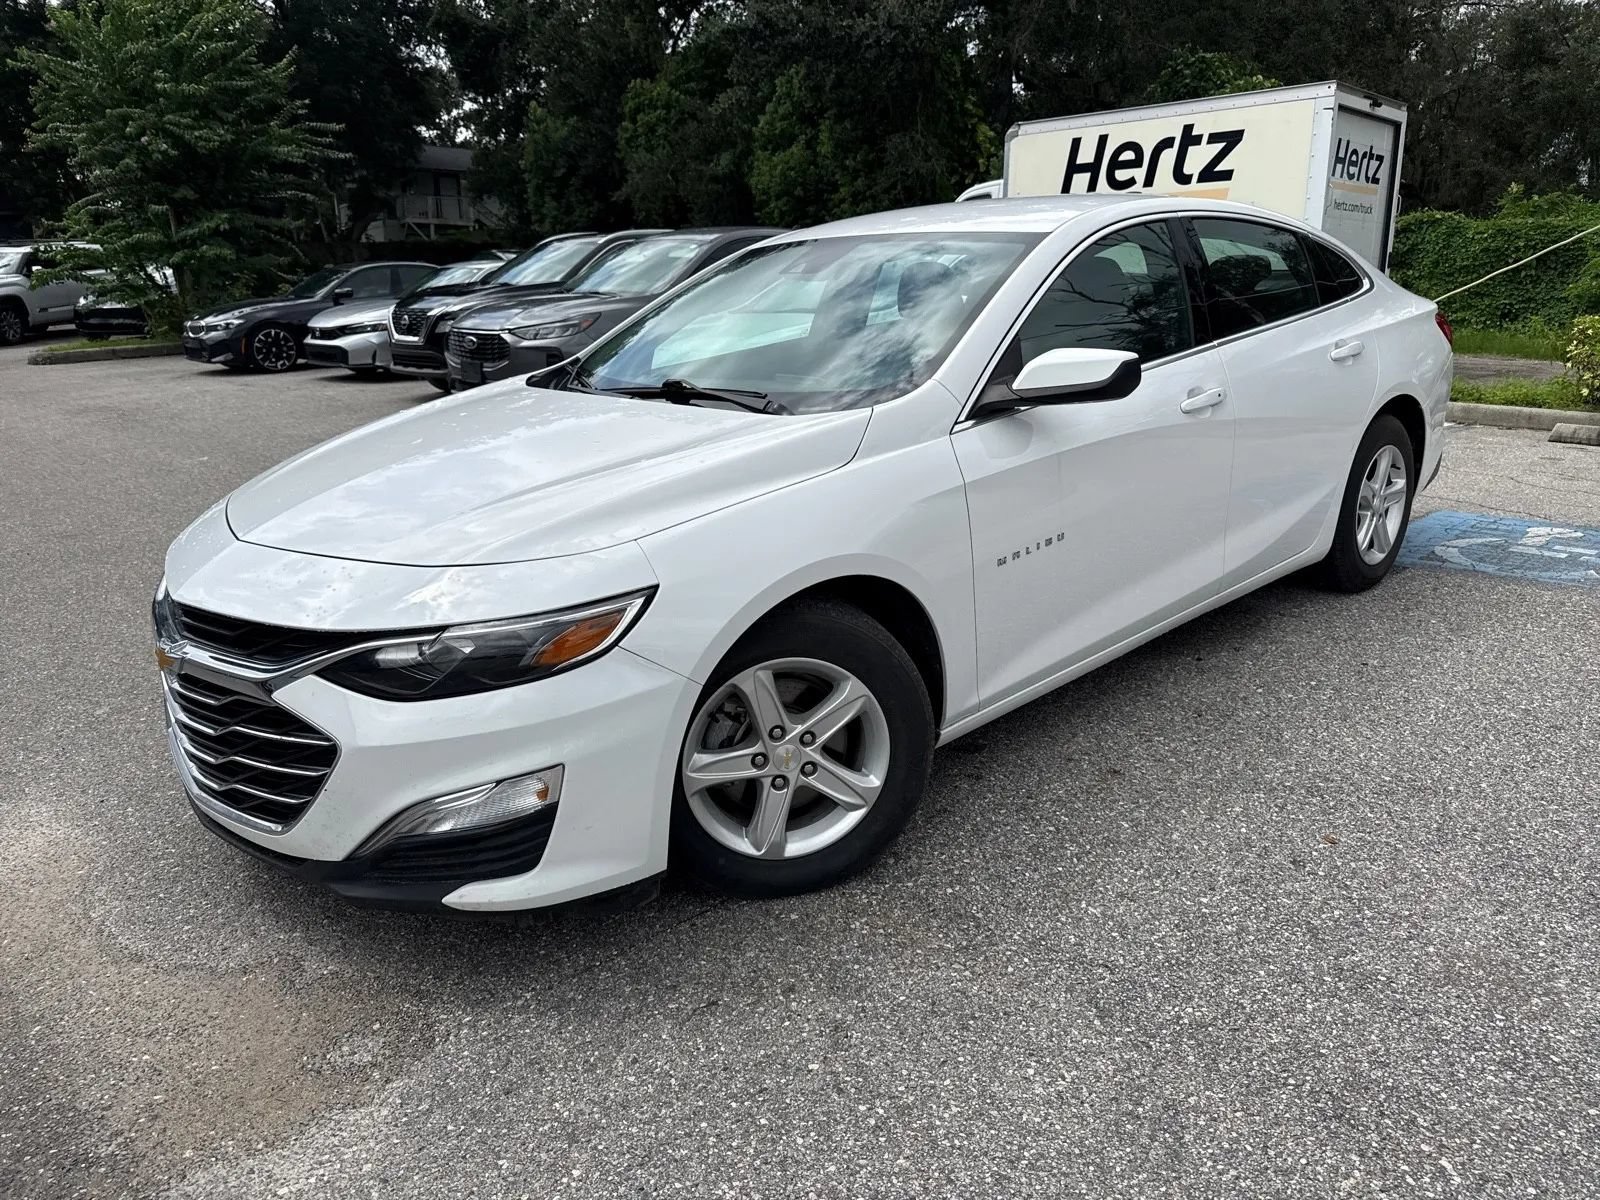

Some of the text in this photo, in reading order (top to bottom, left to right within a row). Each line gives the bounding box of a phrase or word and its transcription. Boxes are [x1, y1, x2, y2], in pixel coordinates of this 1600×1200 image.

[1061, 123, 1245, 194] Hertz
[1331, 137, 1384, 185] Hertz
[997, 532, 1064, 567] MALIBU
